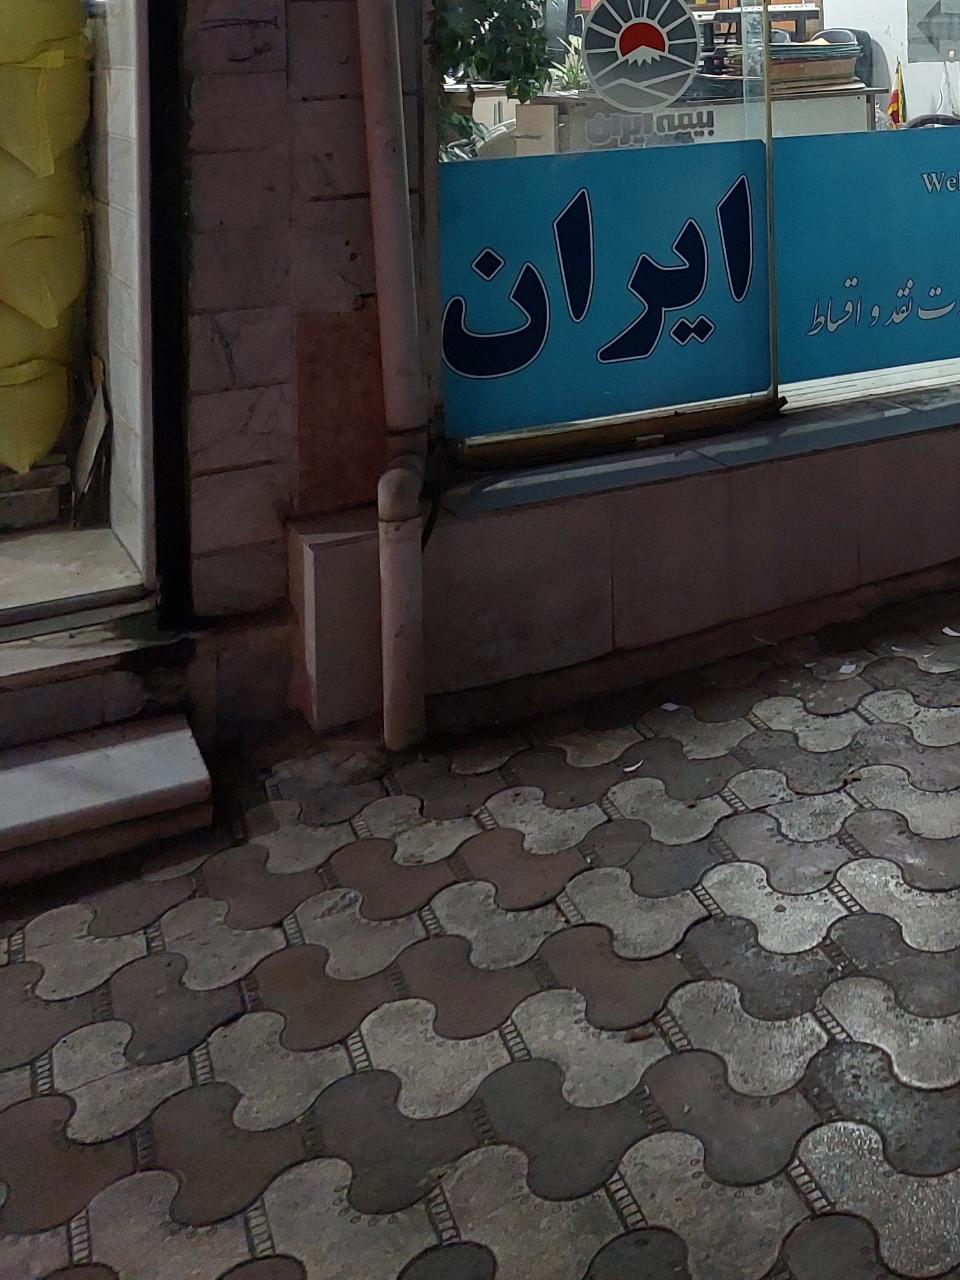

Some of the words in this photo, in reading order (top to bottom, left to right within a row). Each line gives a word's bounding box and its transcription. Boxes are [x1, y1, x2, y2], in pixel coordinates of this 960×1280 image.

[441, 173, 755, 379] ایران
[884, 276, 915, 327] نقد
[806, 276, 863, 336] اقساط
[870, 304, 880, 327] و
